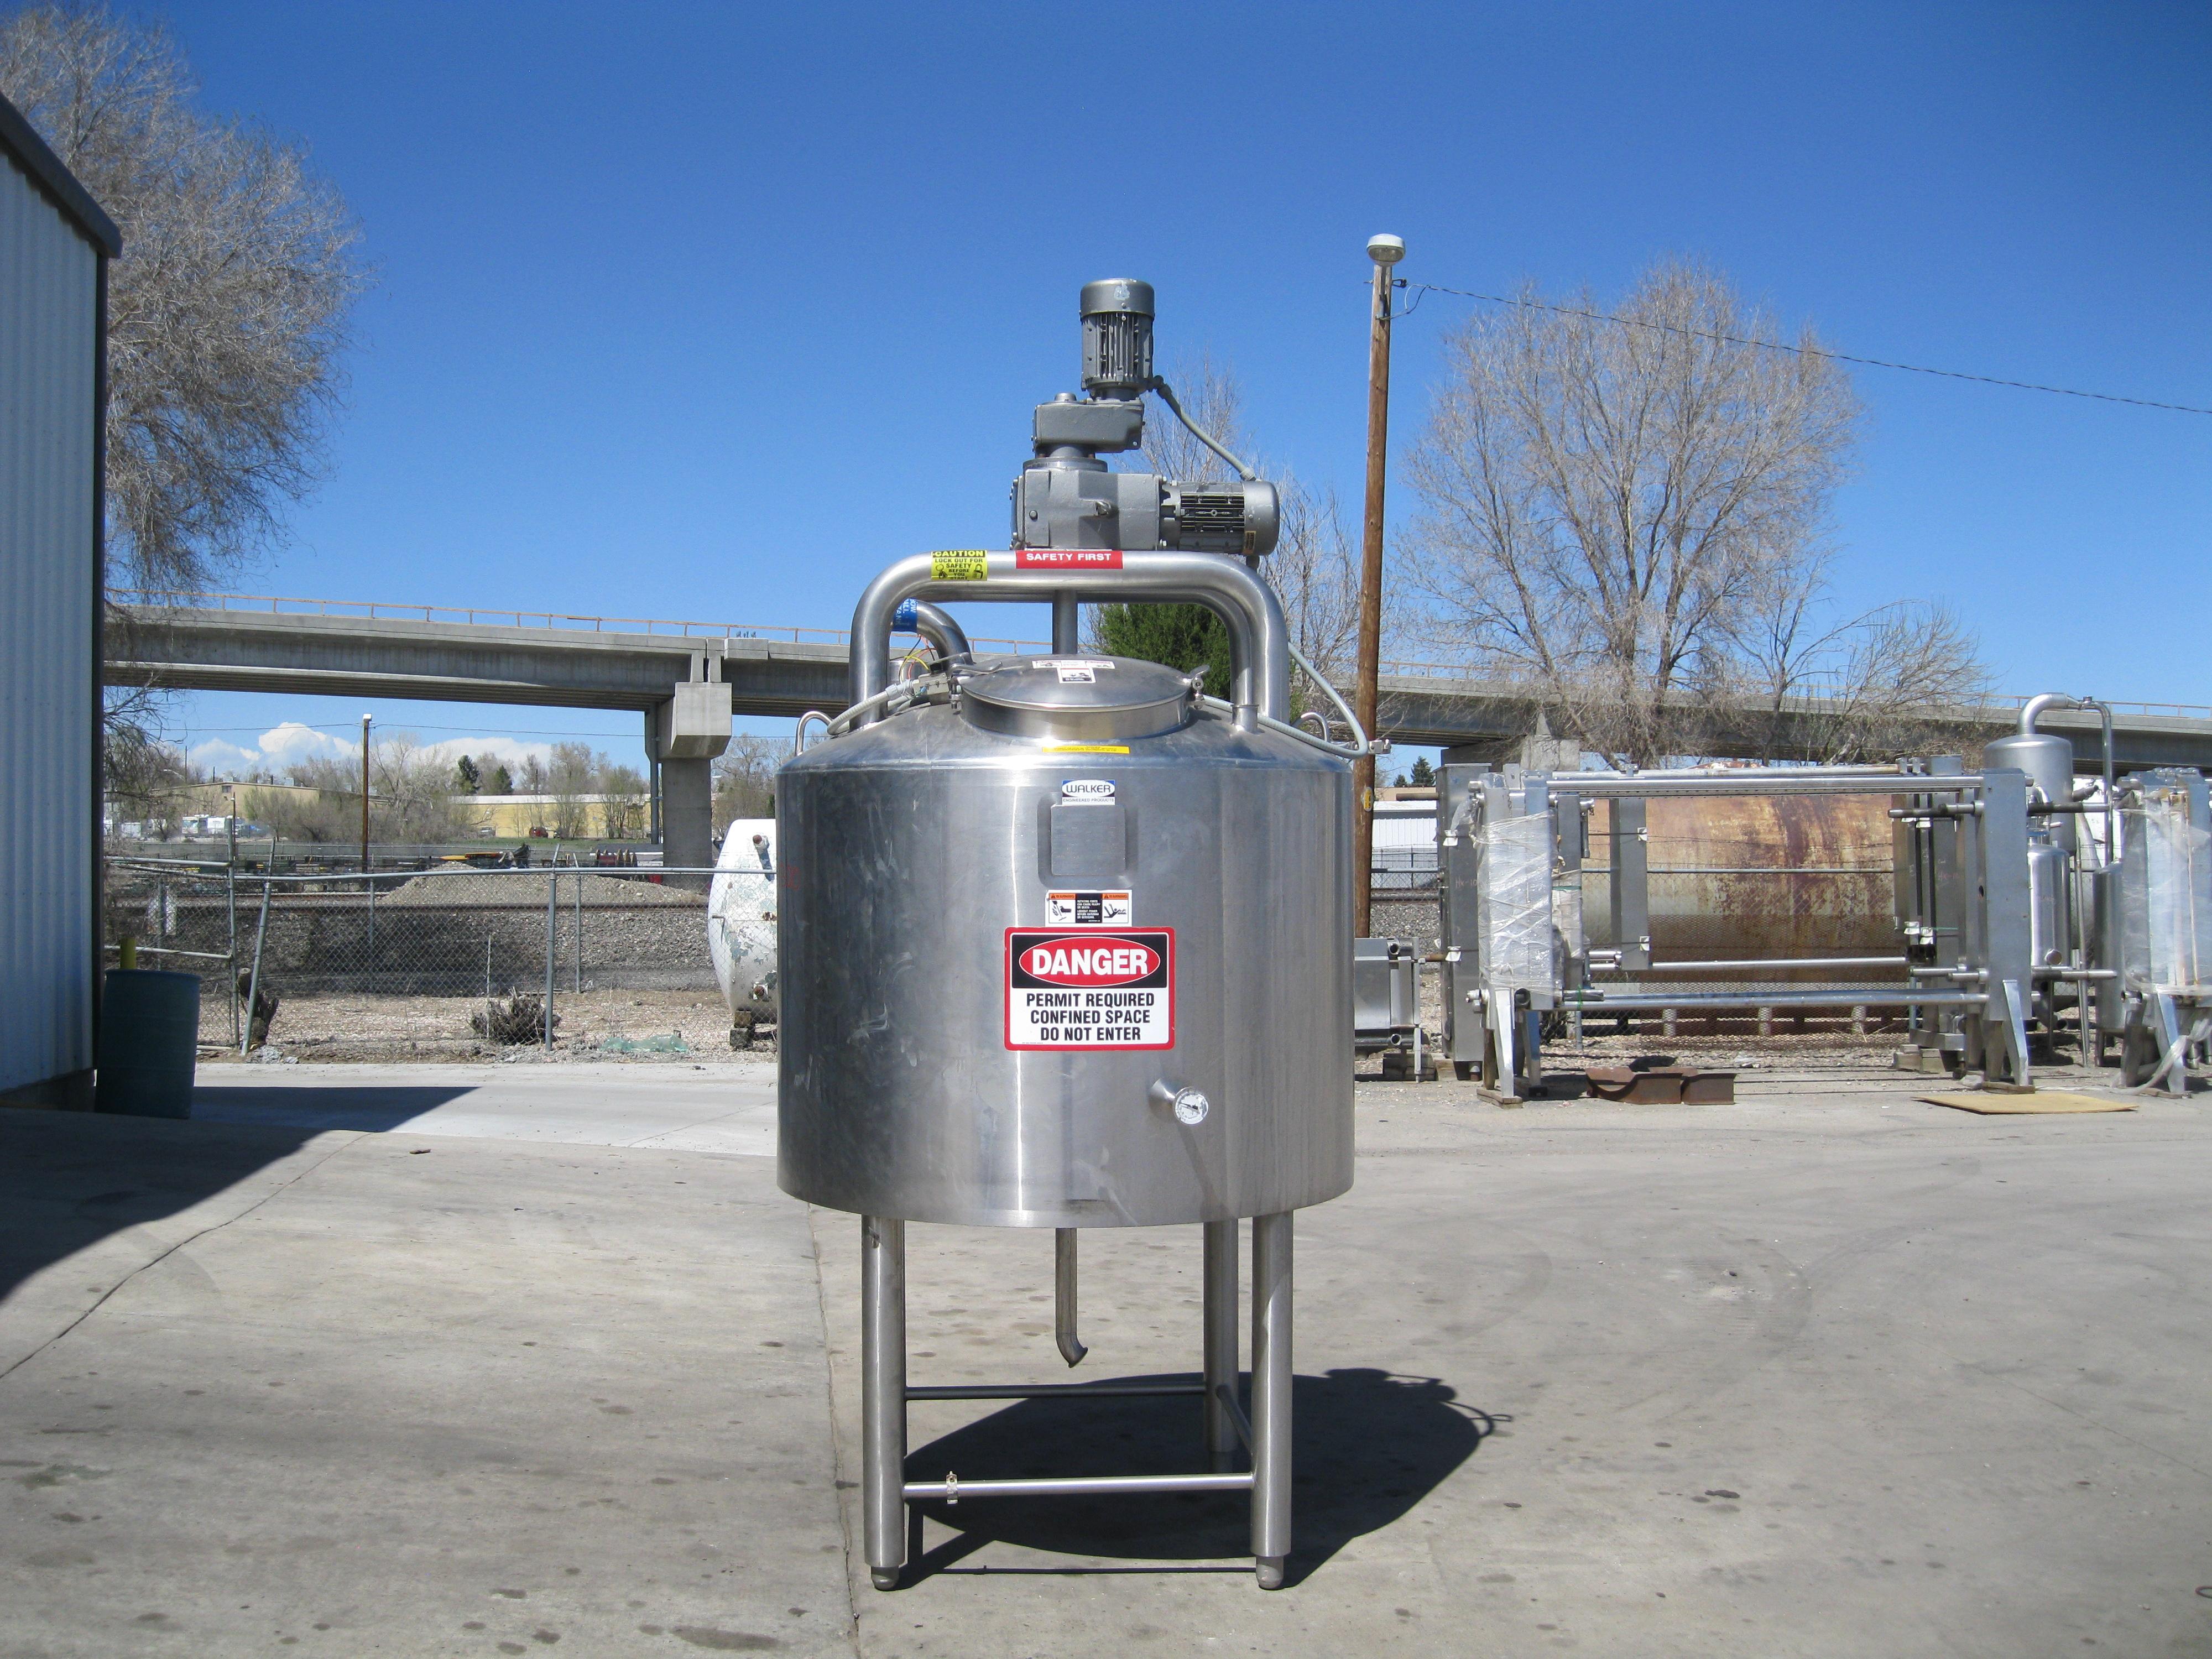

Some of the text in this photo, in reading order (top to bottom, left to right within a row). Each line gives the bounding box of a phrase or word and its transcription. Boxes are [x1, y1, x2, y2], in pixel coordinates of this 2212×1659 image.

[1066, 784, 1111, 793] WALKER
[1032, 948, 1148, 975] DANGER
[1026, 993, 1155, 1009] PERMIT REQUIRED
[1030, 1009, 1150, 1024] CONFINED SPACE
[1040, 1027, 1141, 1041] DO NOT ENTER
